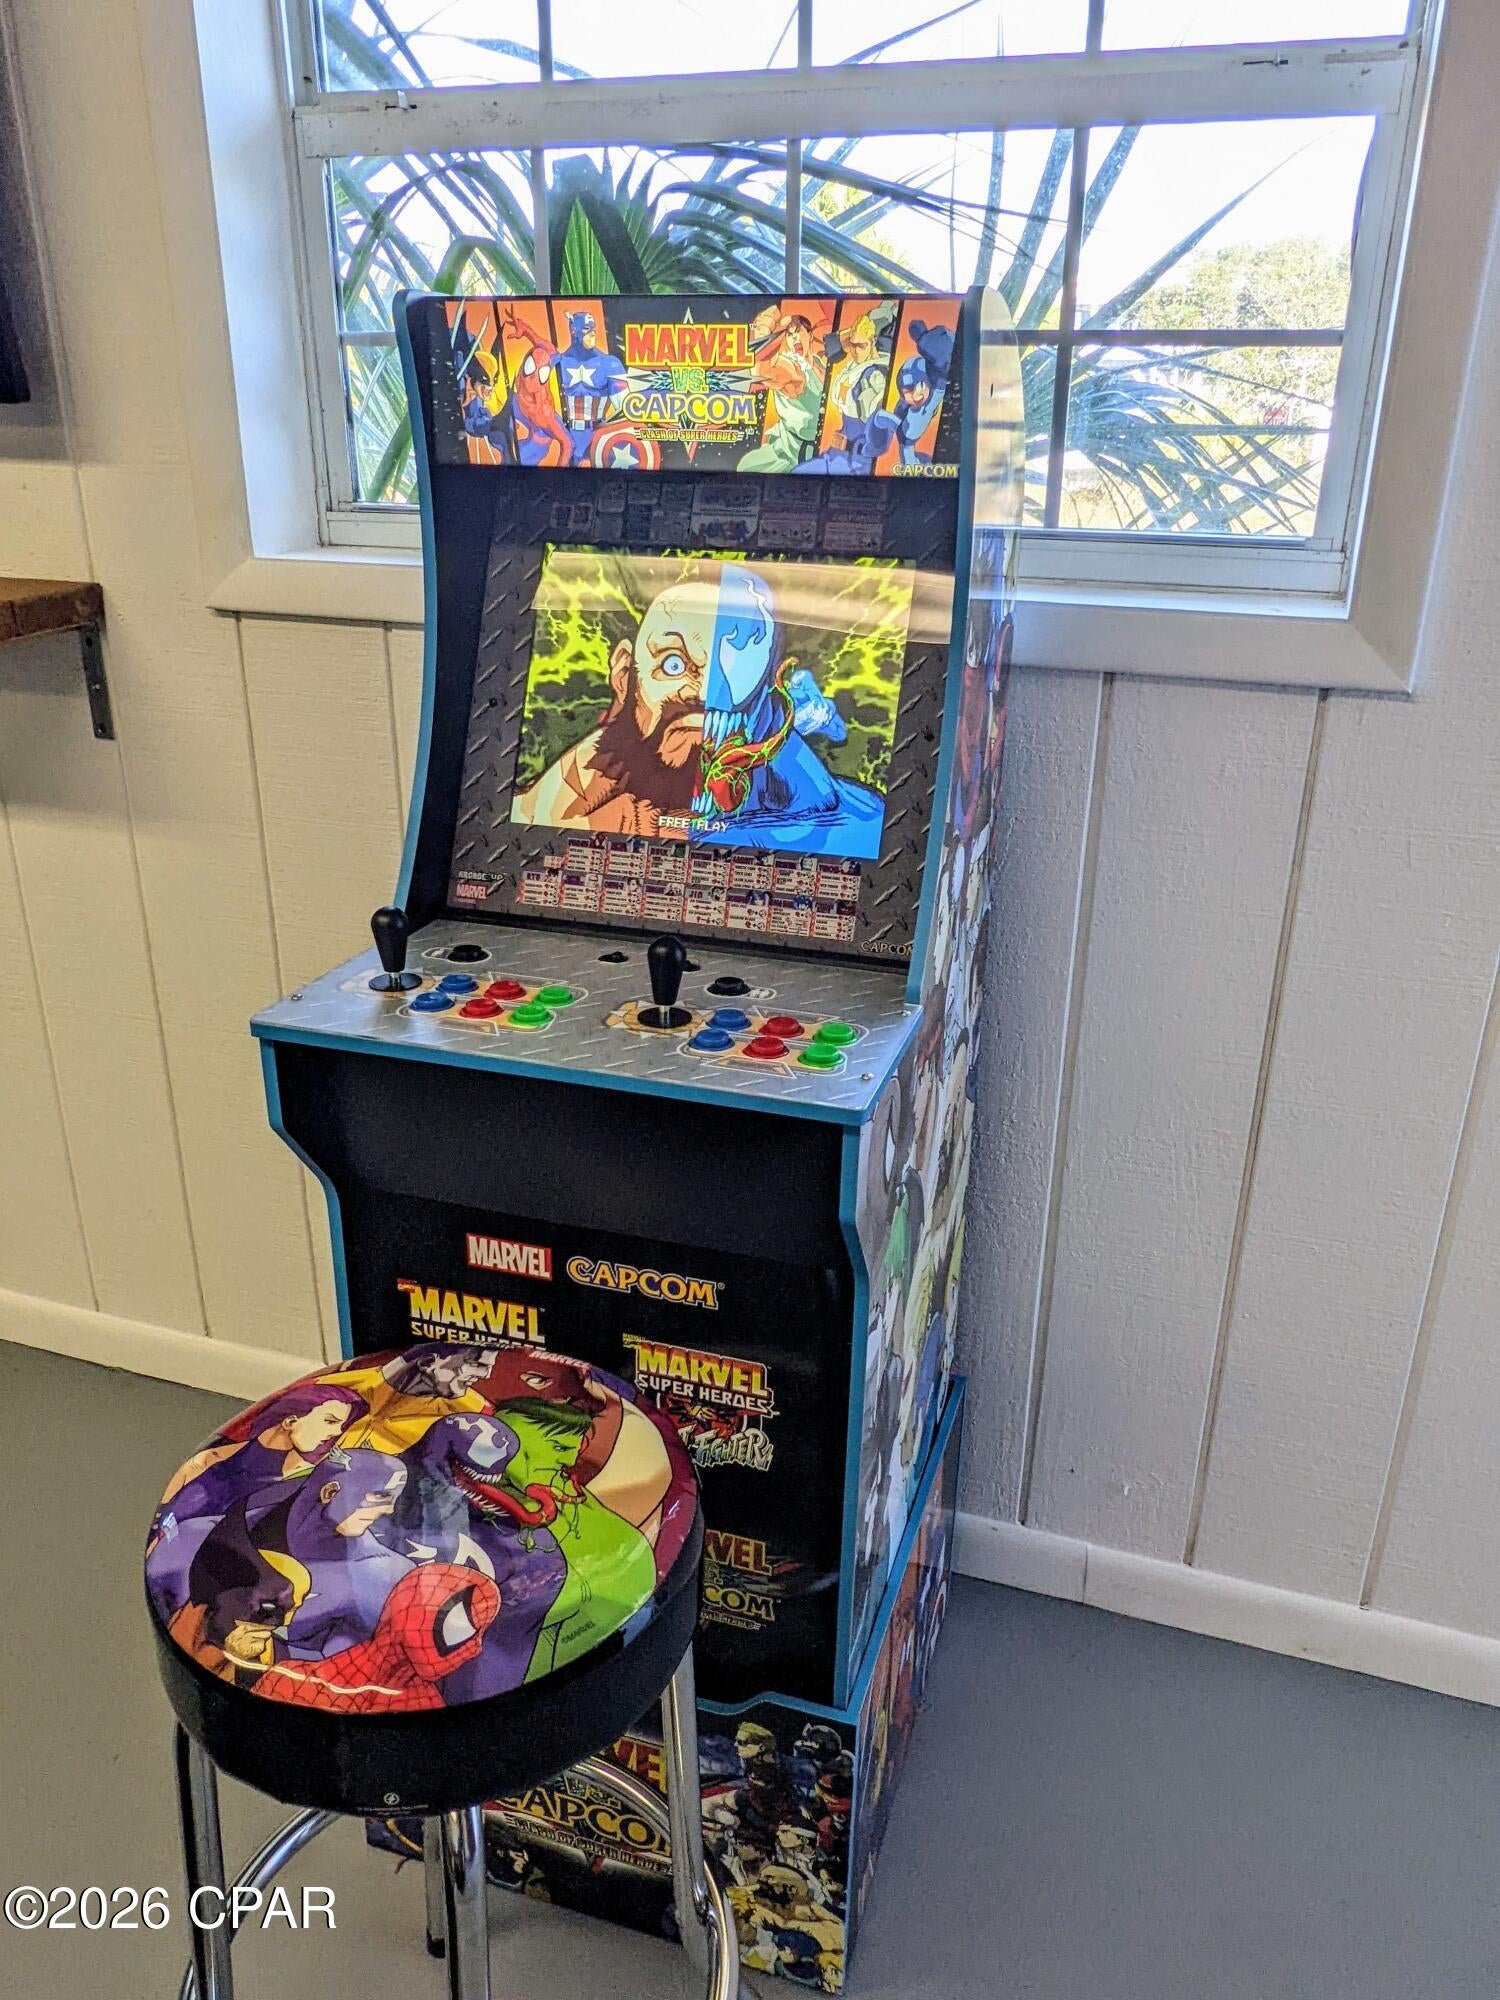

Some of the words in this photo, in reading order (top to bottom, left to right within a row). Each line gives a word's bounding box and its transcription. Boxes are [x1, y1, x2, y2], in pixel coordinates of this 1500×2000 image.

[625, 324, 755, 366] MARVEL
[622, 393, 758, 425] CAPCOM
[640, 429, 667, 440] CLASH
[668, 430, 678, 440] OF
[679, 430, 705, 441] SUPER
[706, 430, 739, 442] HEROES
[891, 463, 959, 478] CAPCOM
[659, 815, 690, 829] FREE
[468, 1236, 550, 1276] MARVEL
[567, 1256, 719, 1310] CAPCOM
[410, 1285, 545, 1343] MARVEL
[639, 1341, 768, 1397] MARVEL
[638, 1373, 694, 1398] SUPER
[699, 1386, 769, 1413] HEROES
